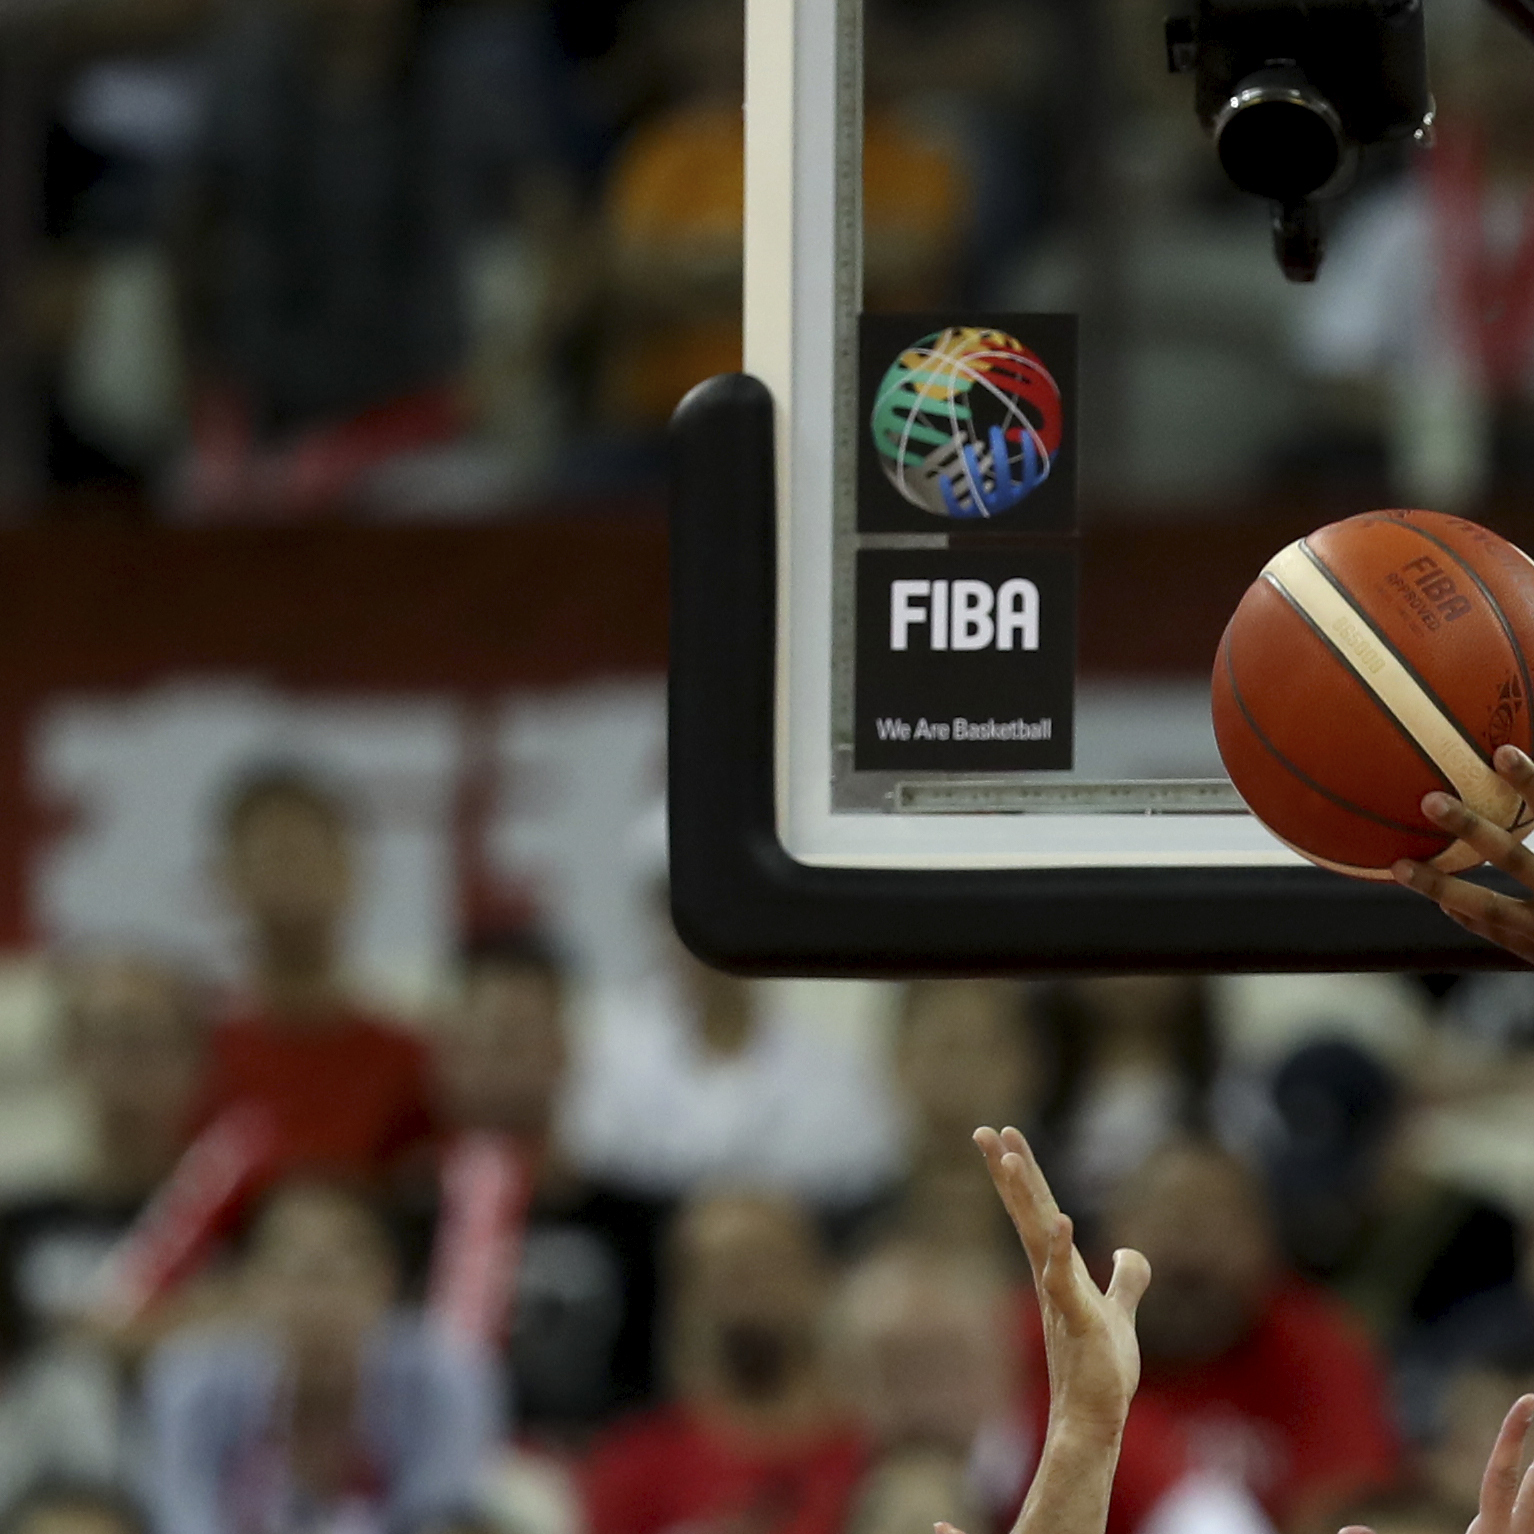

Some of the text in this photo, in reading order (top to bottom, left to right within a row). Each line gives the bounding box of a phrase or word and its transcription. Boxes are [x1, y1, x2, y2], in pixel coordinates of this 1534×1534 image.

[890, 578, 1040, 651] FIBA
[1386, 572, 1440, 631] APPROVED
[1403, 556, 1472, 621] FIBA
[876, 717, 1052, 741] We Are Basketball
